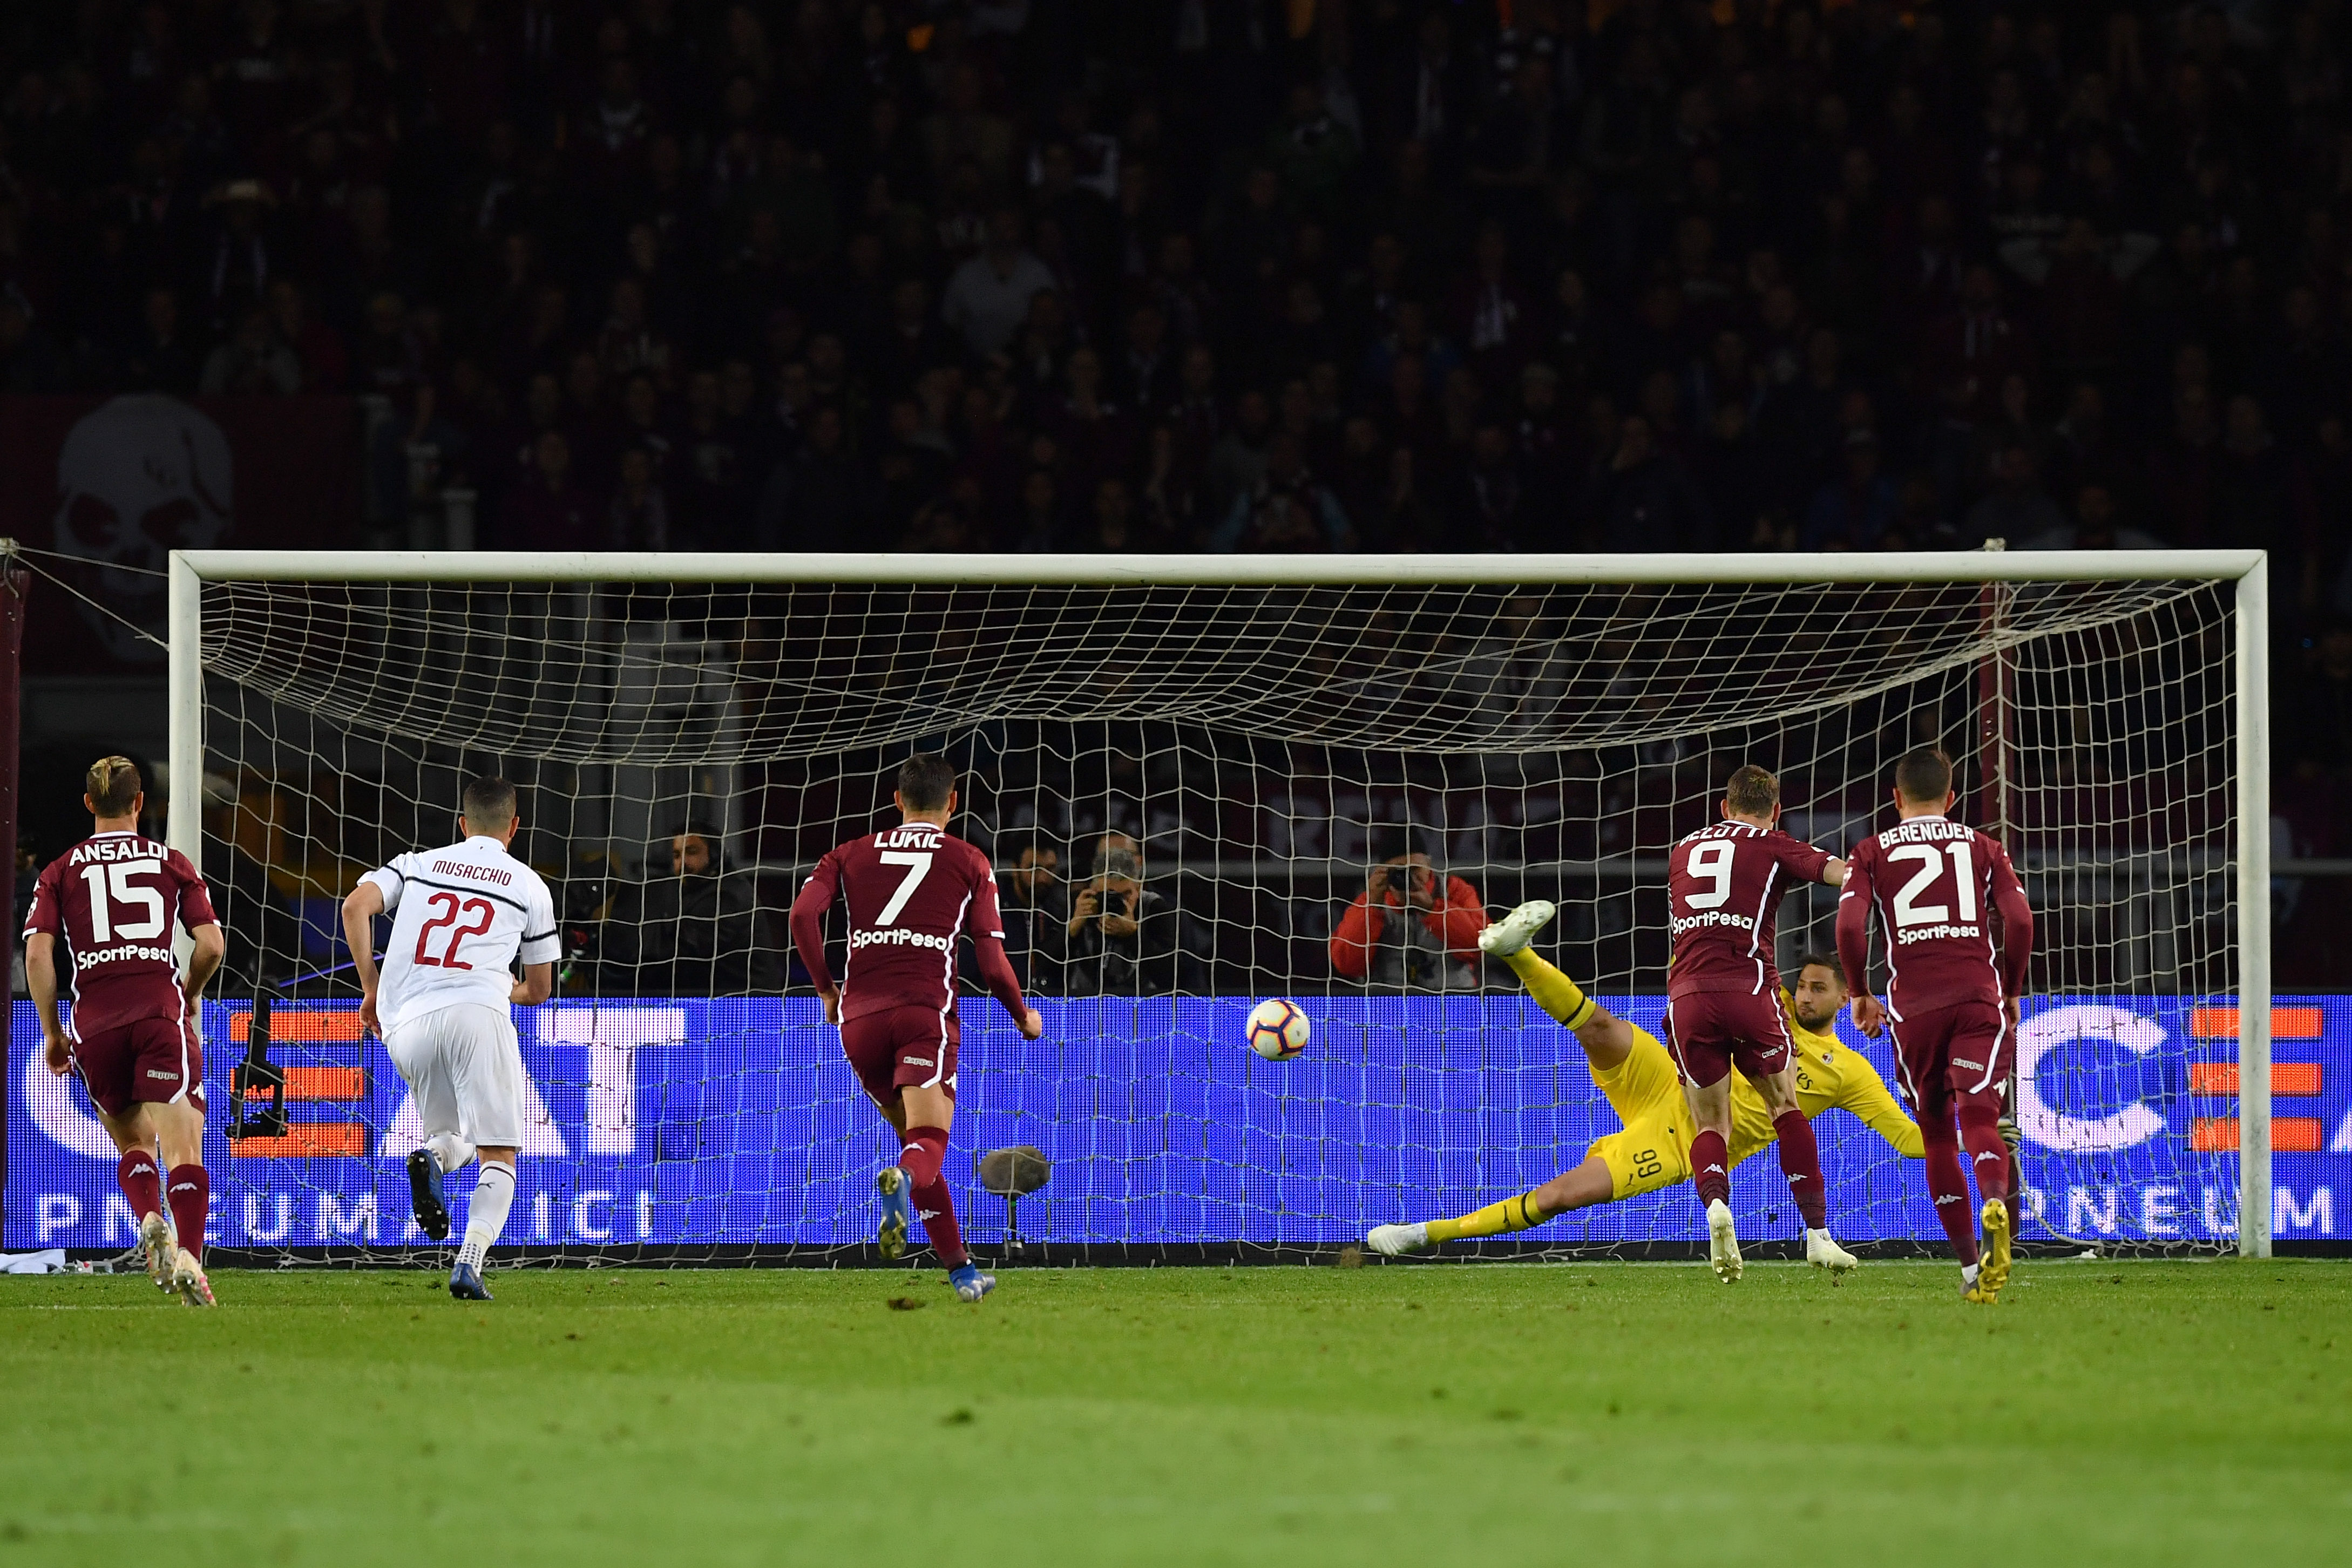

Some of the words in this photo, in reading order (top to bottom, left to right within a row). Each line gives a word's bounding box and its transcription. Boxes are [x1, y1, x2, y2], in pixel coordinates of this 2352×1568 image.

[1879, 823, 1975, 850] BERENGUER
[69, 840, 168, 866] ANSALDI
[432, 860, 512, 886] MUSACCHIO
[1685, 839, 1736, 909] 9
[1887, 841, 1976, 927] 21
[80, 859, 165, 943] 15
[875, 851, 933, 925] 7
[415, 892, 495, 970] 22
[1672, 911, 1753, 934] SportPesa
[1897, 925, 1980, 945] SportPesa
[852, 929, 948, 951] SportPesa
[78, 945, 169, 969] SportPesa
[904, 1056, 933, 1067] Kappa
[2016, 1005, 2352, 1152] CE
[1633, 1149, 1662, 1178] 99
[38, 1190, 652, 1241] PNUMICI
